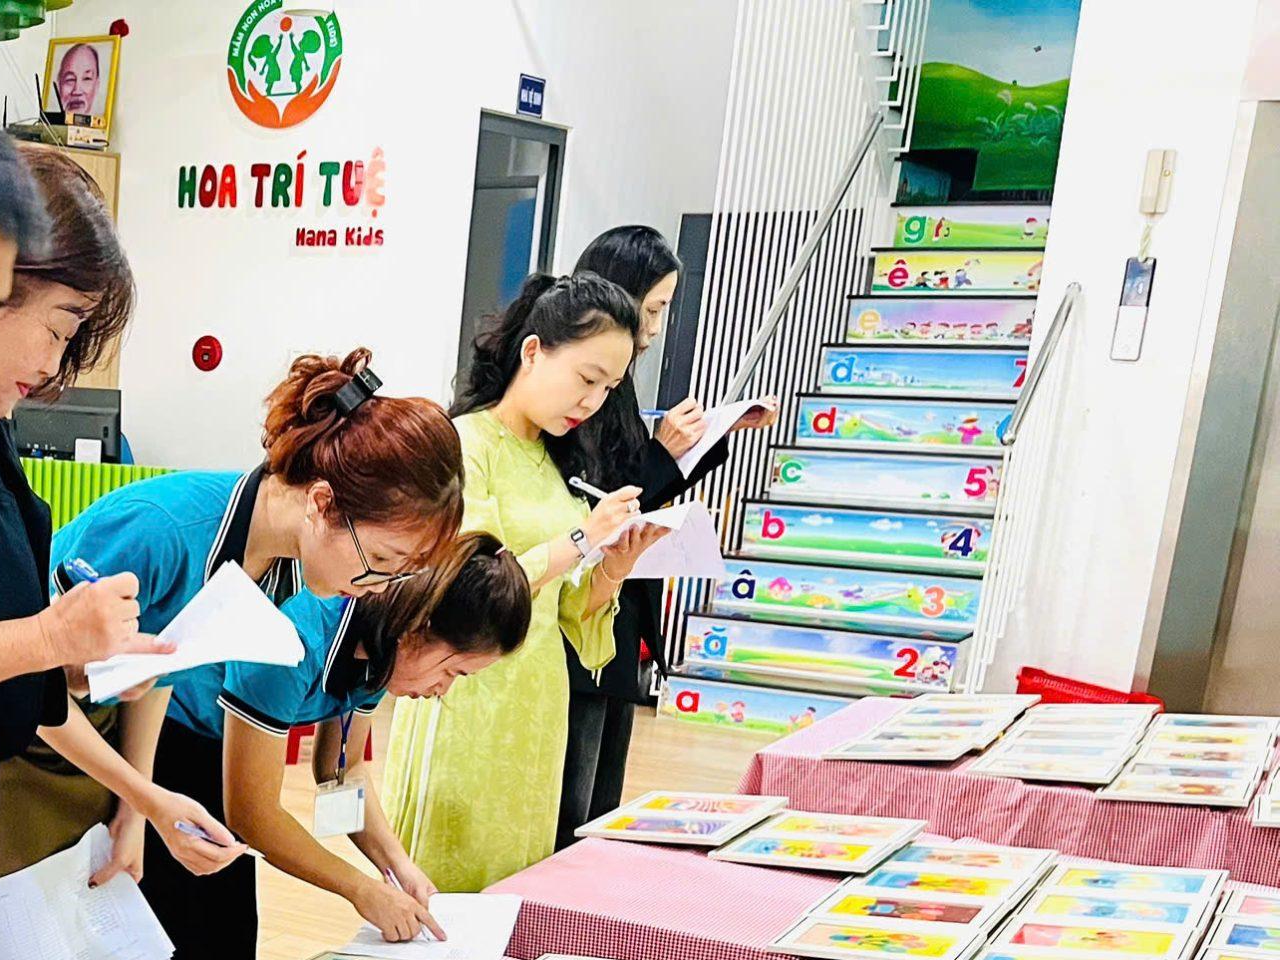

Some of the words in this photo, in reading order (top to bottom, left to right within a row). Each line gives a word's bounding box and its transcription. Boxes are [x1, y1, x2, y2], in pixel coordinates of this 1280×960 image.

[242, 10, 259, 31] NON
[178, 164, 237, 209] HOA
[250, 149, 307, 208] TRÍ
[319, 146, 386, 218] TUỆ
[295, 227, 337, 247] Hana
[345, 226, 384, 246] Kids
[904, 215, 927, 243] g
[887, 259, 909, 288] ê
[859, 310, 880, 331] e
[1012, 360, 1028, 388] 7
[812, 406, 837, 434] d
[781, 461, 802, 483] c
[963, 468, 987, 497] 5
[761, 510, 785, 539] b
[948, 528, 973, 557] 4
[732, 569, 756, 600] â
[921, 586, 945, 616] 3
[703, 626, 728, 657] ă
[893, 647, 919, 678] 2
[676, 690, 700, 713] a
